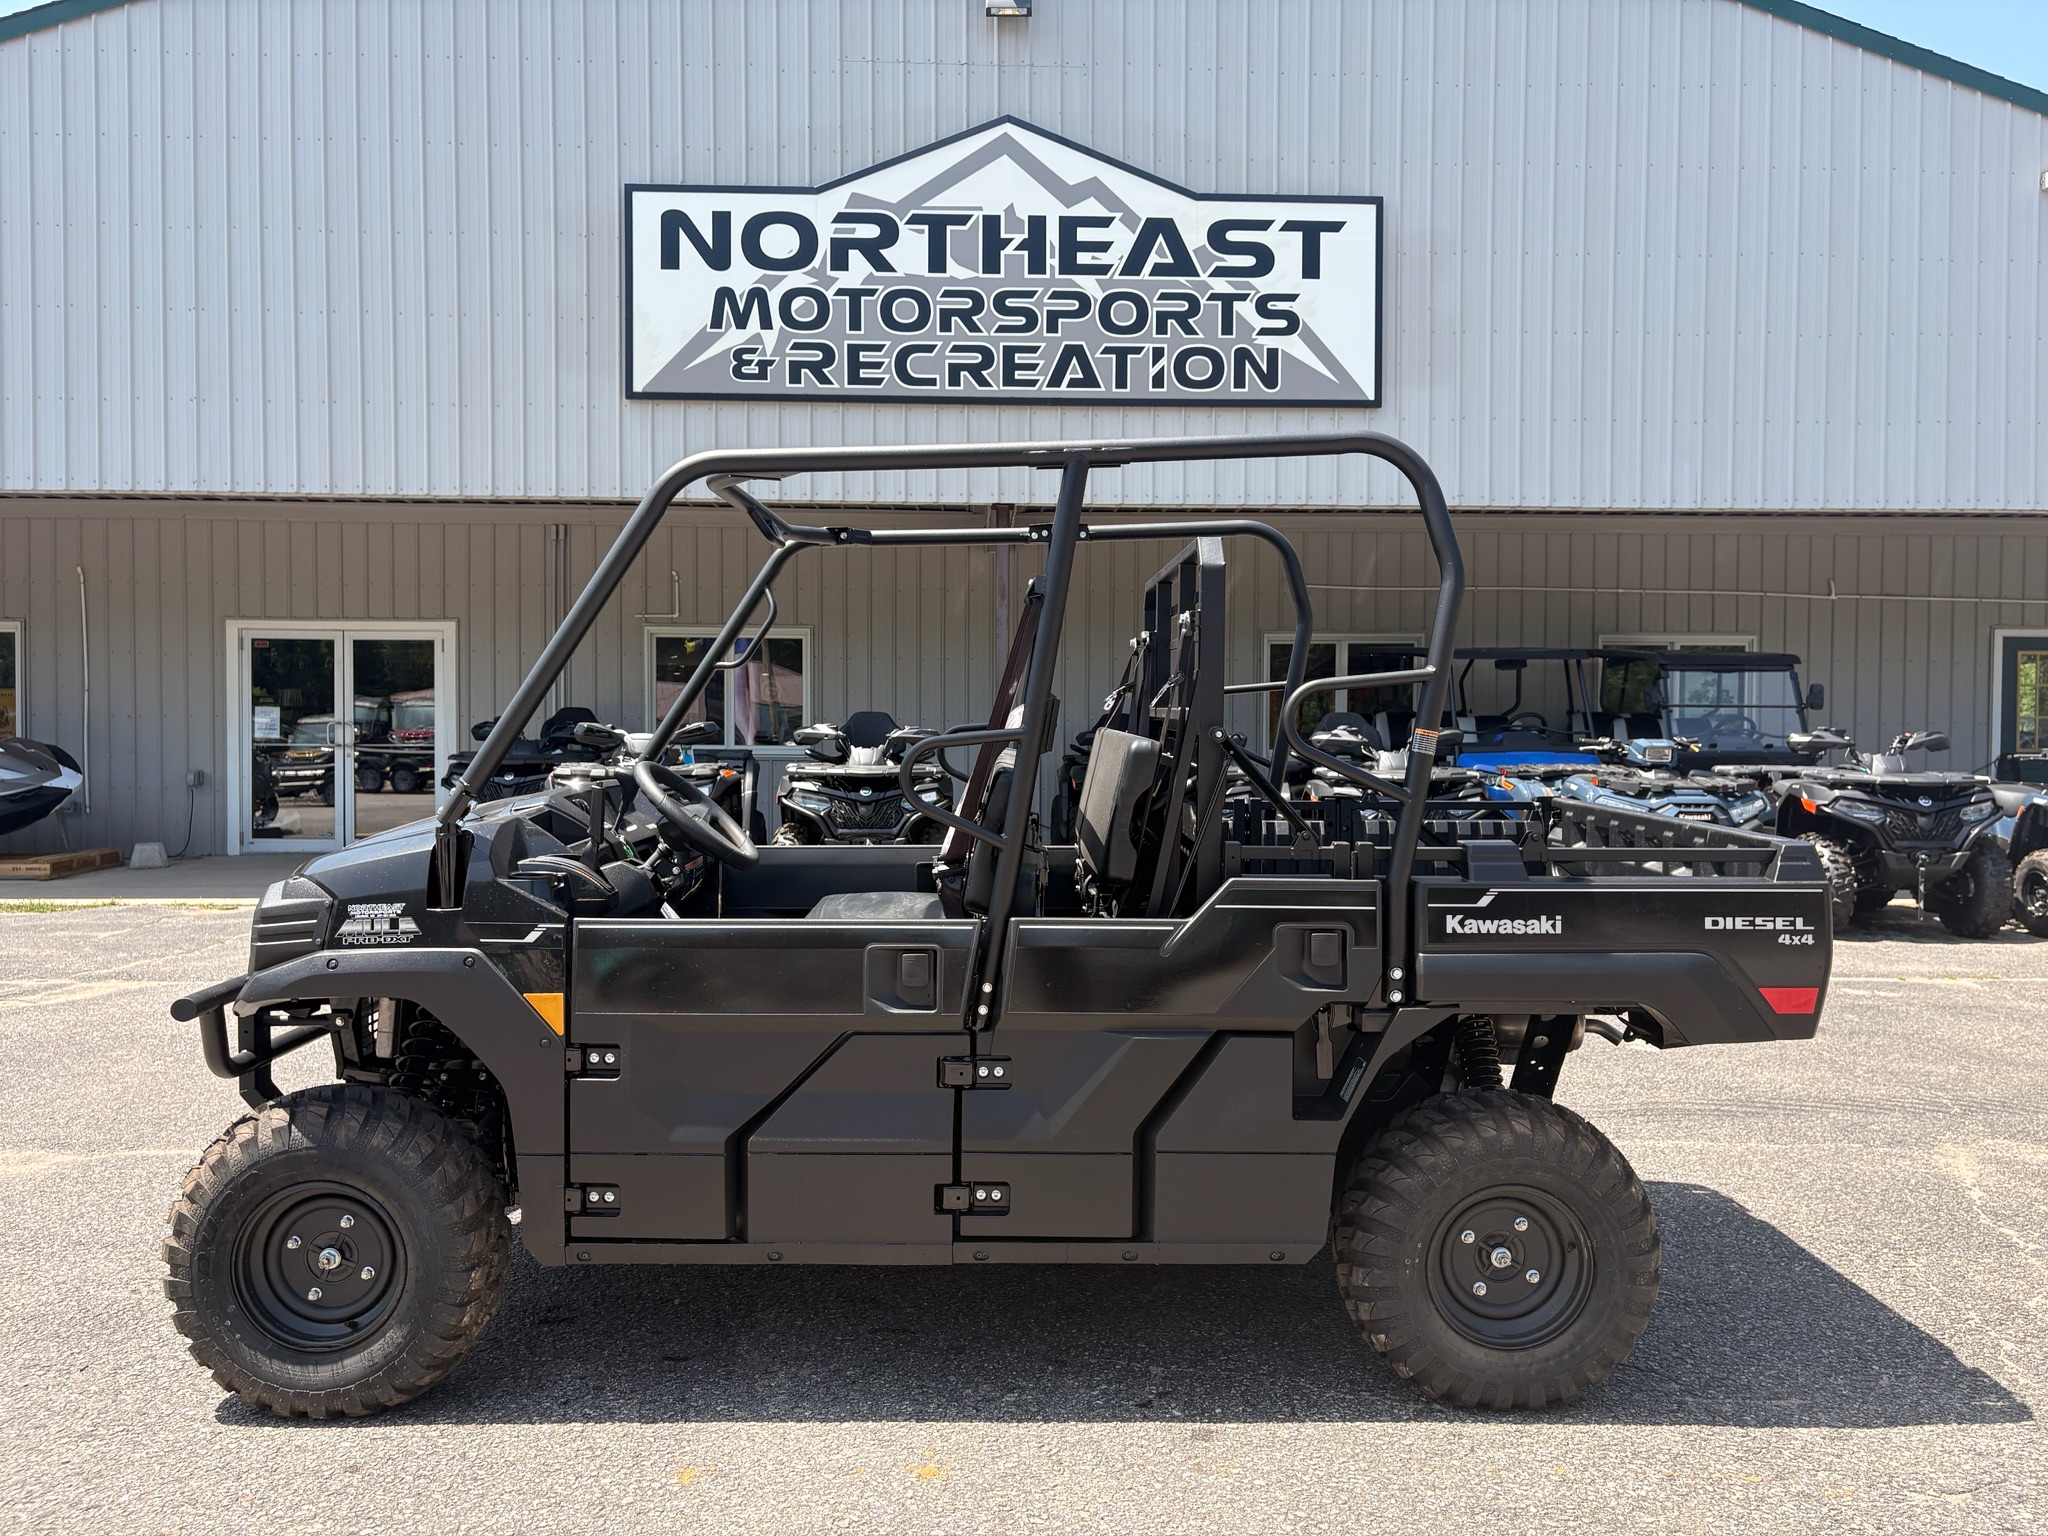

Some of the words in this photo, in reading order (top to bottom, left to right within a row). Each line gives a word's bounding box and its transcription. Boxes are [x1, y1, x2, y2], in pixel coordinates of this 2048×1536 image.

[660, 209, 1347, 280] NORTHEAST
[709, 286, 1301, 337] MOTORSPORTS
[335, 917, 422, 938] MULE
[1445, 914, 1562, 934] Kawasaki
[1704, 916, 1815, 930] DIESEL
[1777, 934, 1815, 945] 4x4
